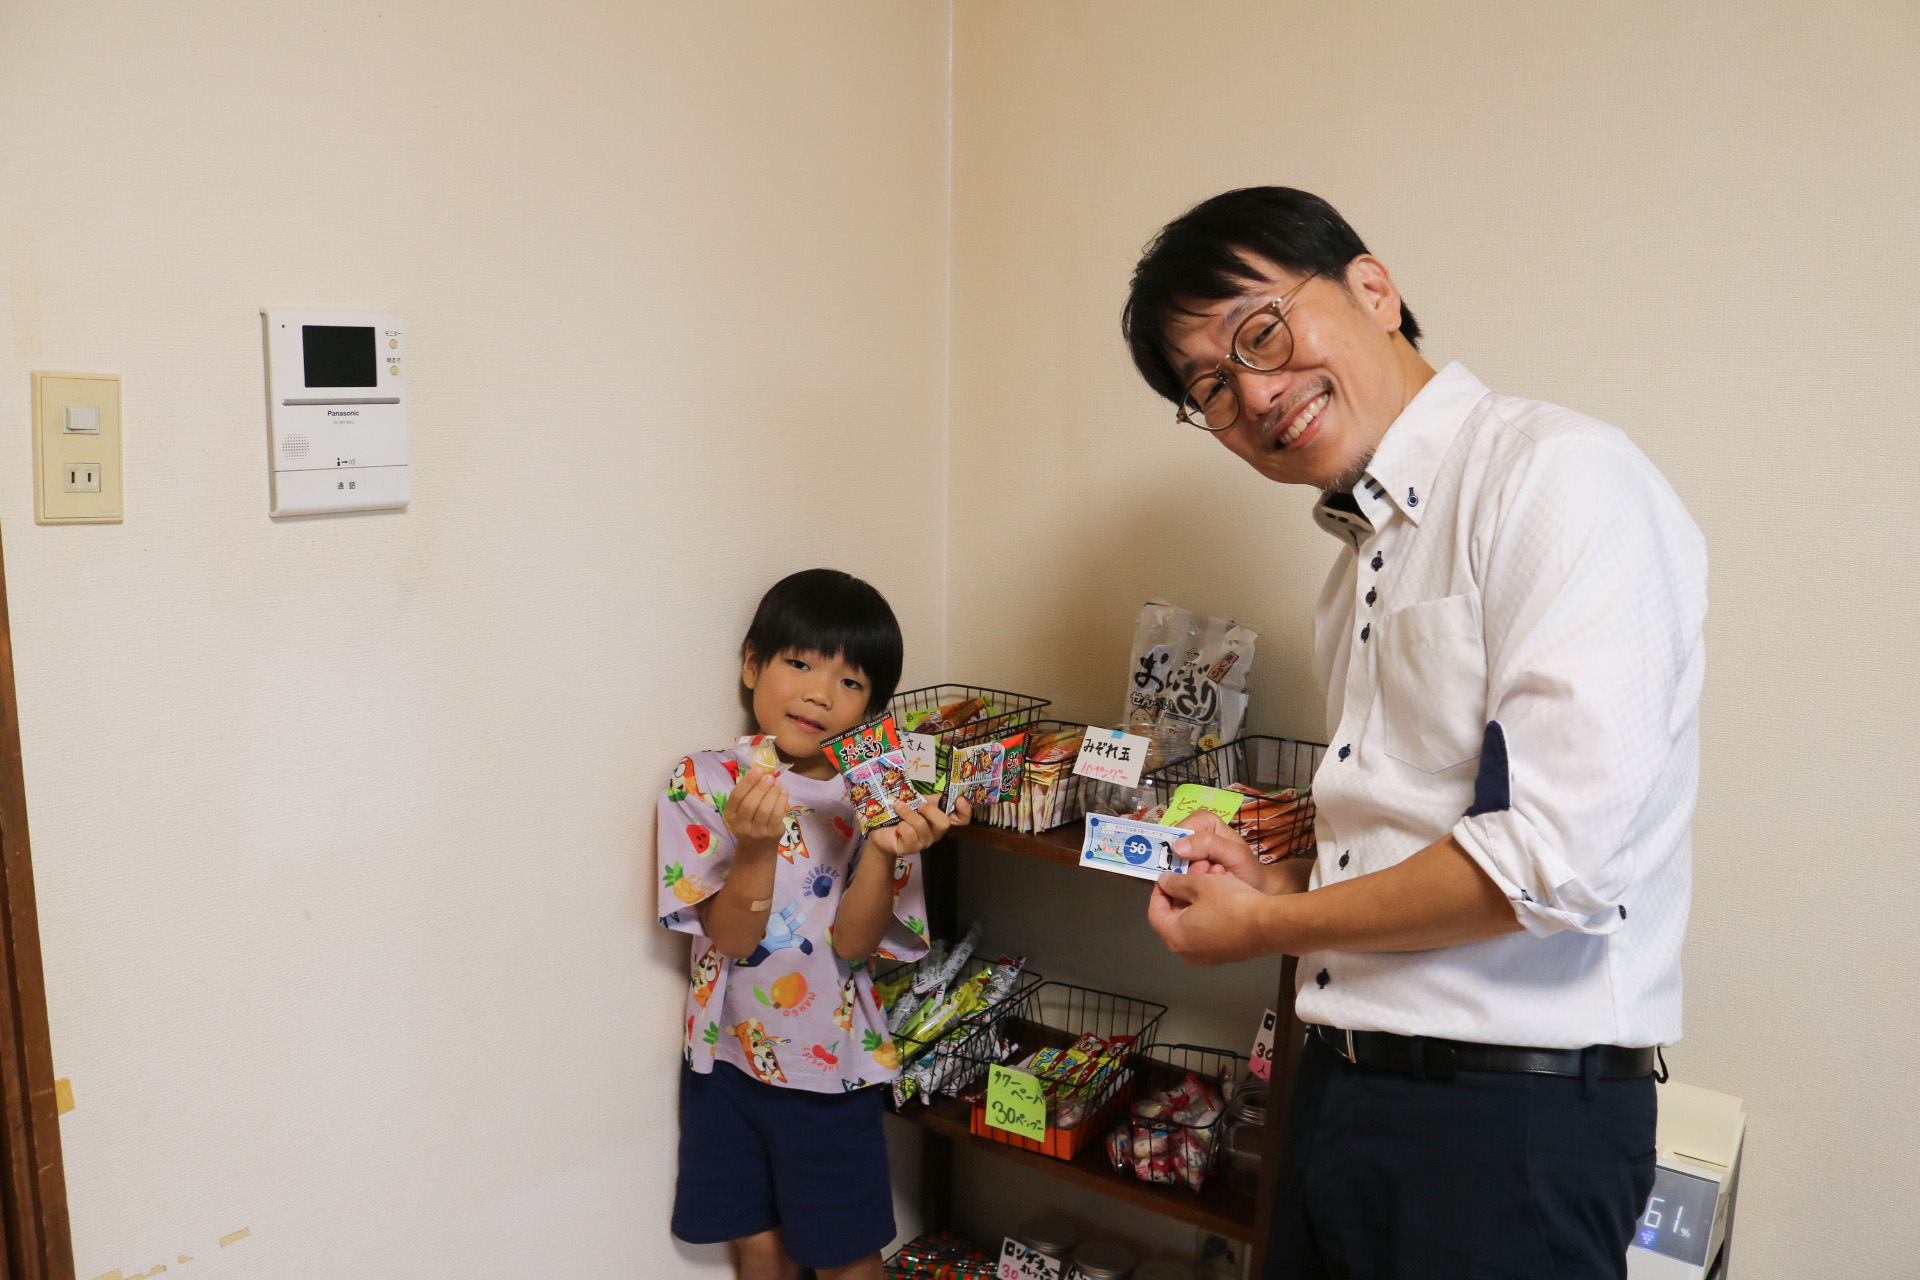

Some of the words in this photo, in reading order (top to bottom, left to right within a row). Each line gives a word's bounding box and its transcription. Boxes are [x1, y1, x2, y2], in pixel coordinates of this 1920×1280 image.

[1134, 652, 1217, 722] おにぎり
[840, 734, 884, 763] おにぎり
[1083, 738, 1131, 761] みぞれ玉
[1129, 841, 1147, 855] 50
[802, 863, 841, 897] BLUEBERRY
[782, 991, 817, 1018] MANGO
[1001, 1263, 1019, 1280] 30
